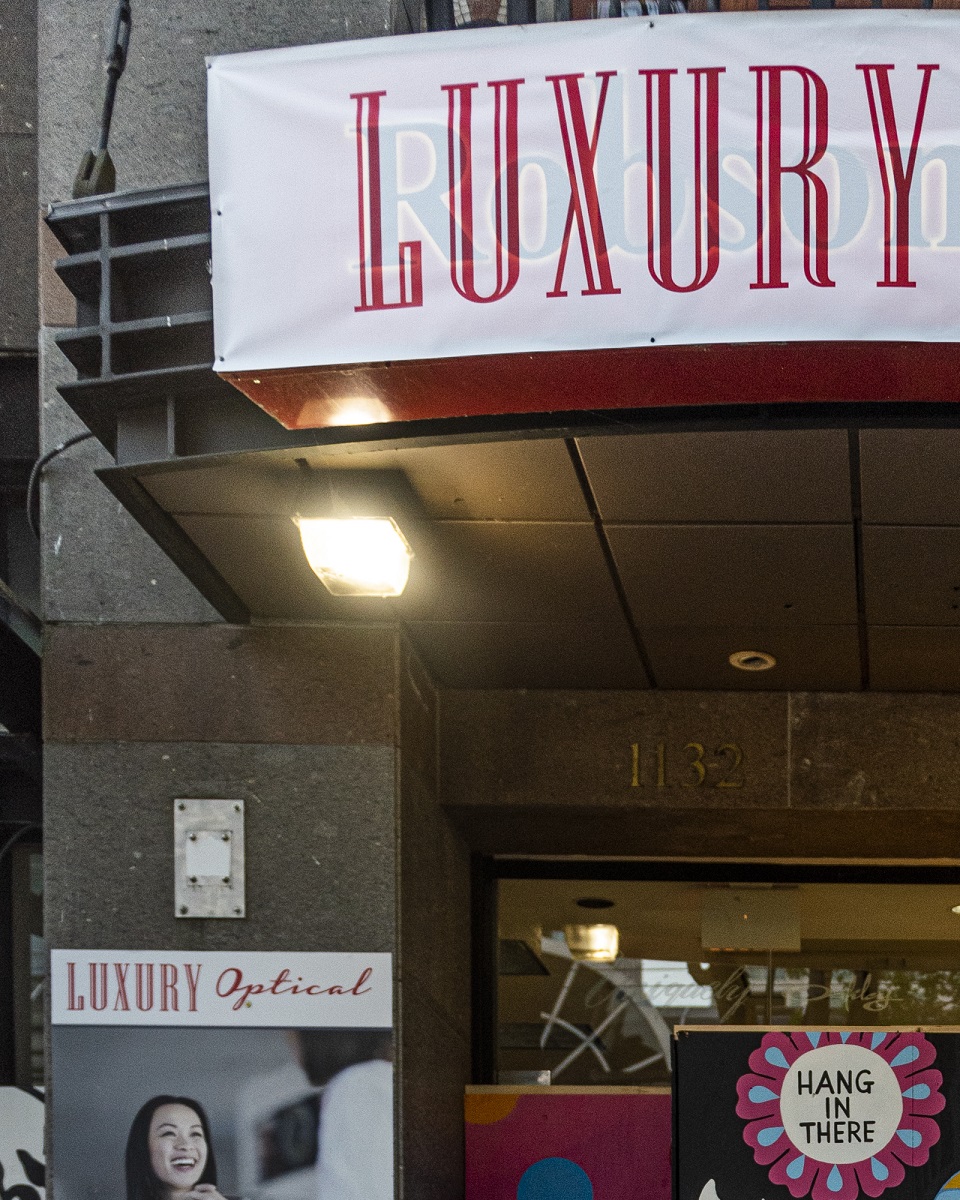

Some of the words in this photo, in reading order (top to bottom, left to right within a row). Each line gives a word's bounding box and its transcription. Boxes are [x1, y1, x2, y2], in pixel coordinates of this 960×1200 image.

[350, 63, 939, 312] LUXURY
[630, 742, 743, 787] 1132
[66, 962, 202, 1012] LUXURY
[215, 967, 373, 1011] Optical
[797, 1069, 875, 1095] HANG
[826, 1097, 850, 1119] IN
[799, 1121, 876, 1144] THERE
